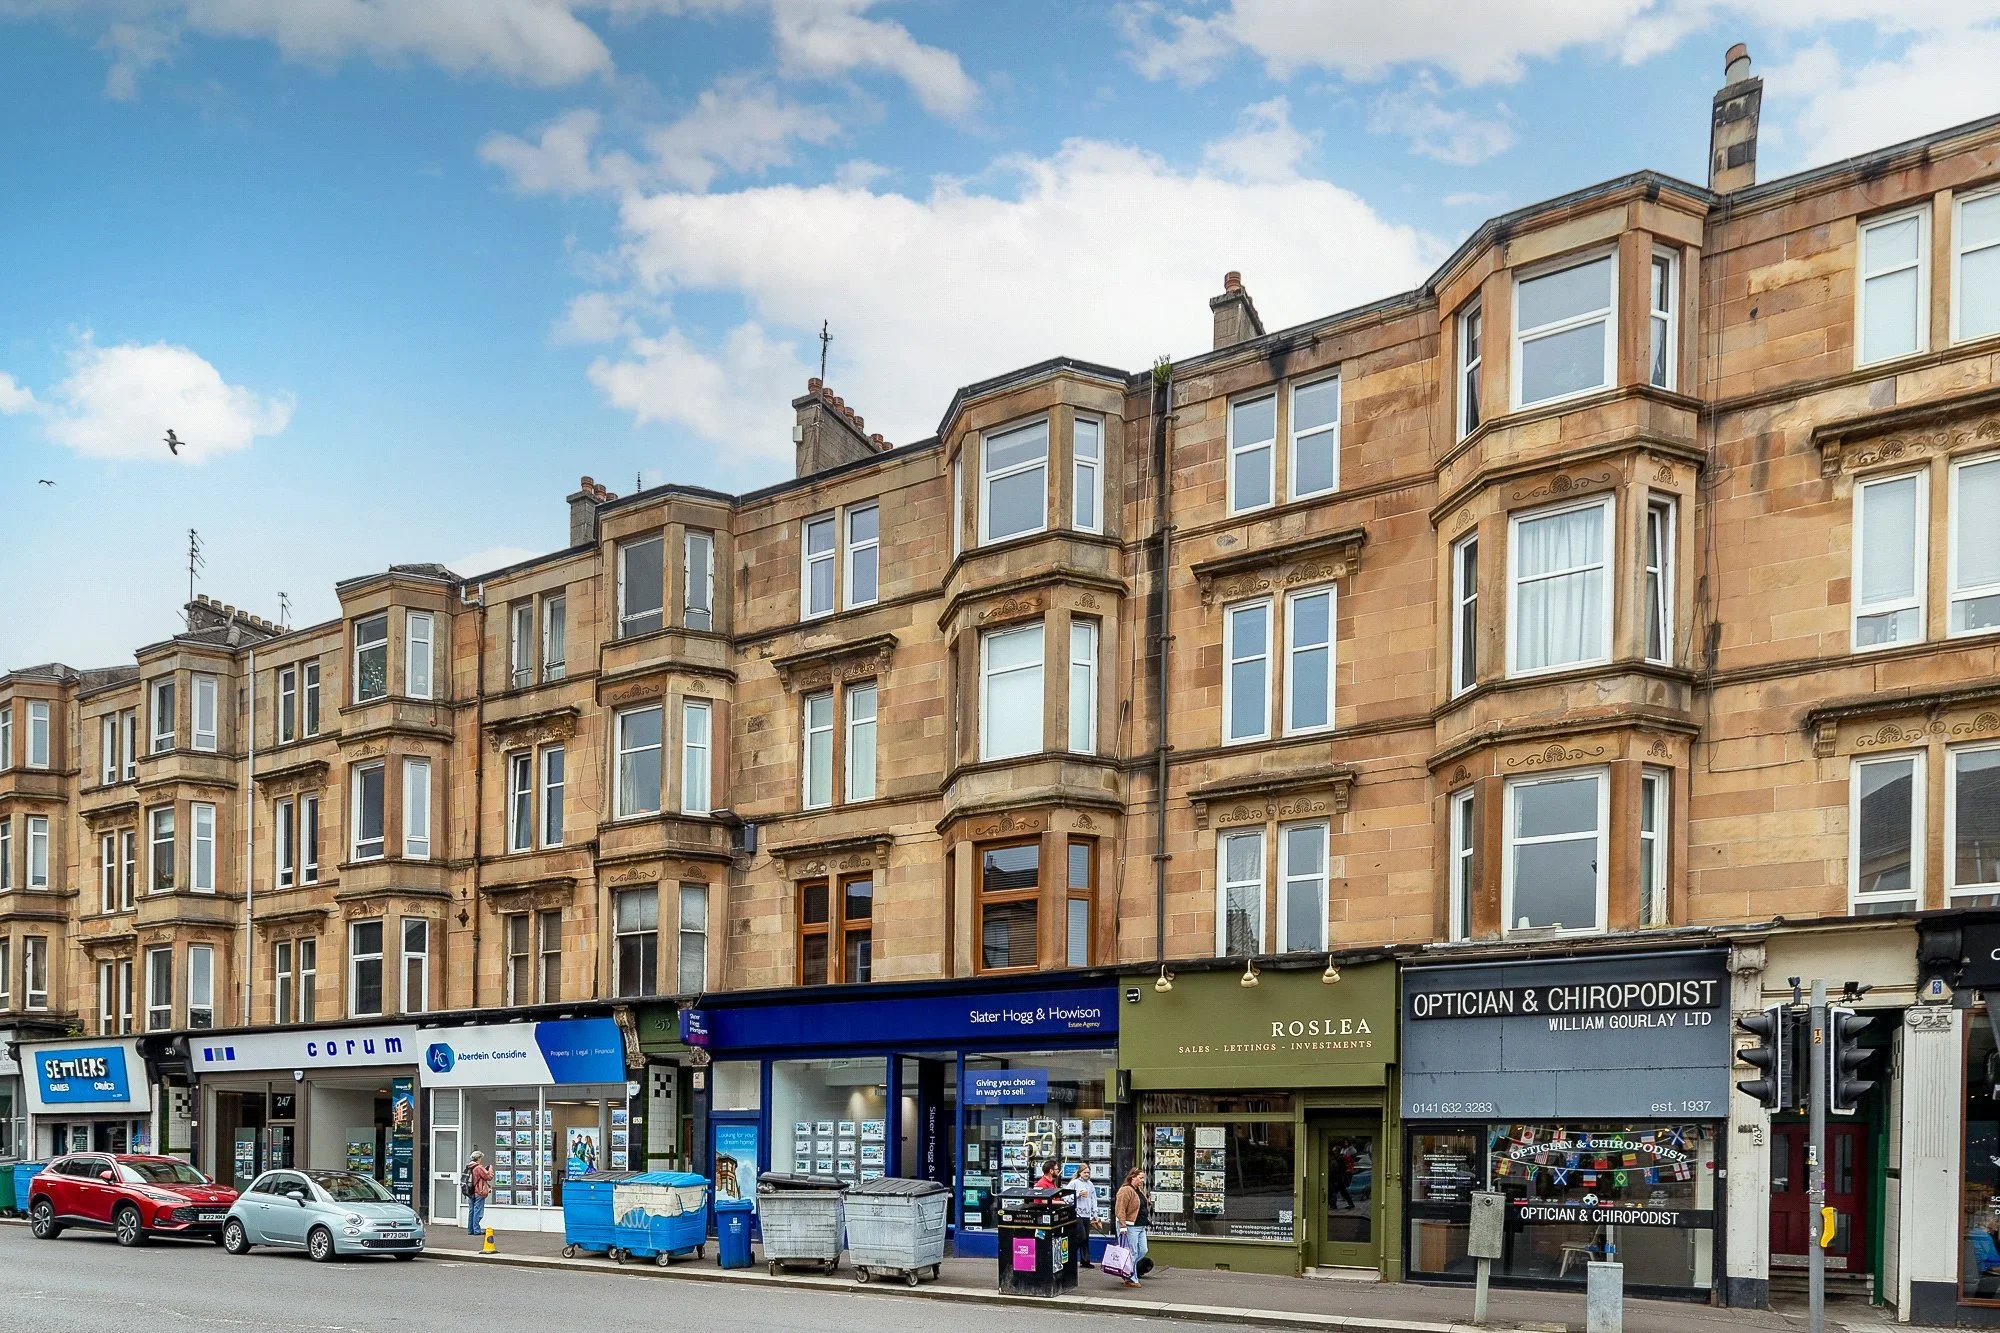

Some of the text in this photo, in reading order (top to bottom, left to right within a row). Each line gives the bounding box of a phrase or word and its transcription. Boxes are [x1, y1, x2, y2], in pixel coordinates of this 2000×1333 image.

[1413, 980, 1717, 1017] OPTICIAN & CHIROPODIST
[969, 1006, 1101, 1024] Slater Hogg & Howison
[1548, 1012, 1712, 1031] WILLIAM GOURLAY LTD
[1082, 1021, 1101, 1029] Agency
[1271, 1018, 1372, 1037] ROSLEA
[306, 1037, 403, 1057] corum
[457, 1049, 527, 1061] Aberdein Considine
[1178, 1045, 1210, 1054] SALES
[1223, 1043, 1277, 1052] LETTINGS
[1291, 1041, 1373, 1051] INVESTMENTS
[45, 1057, 106, 1079] SETTLERS
[49, 1083, 70, 1092] GAMES
[975, 1088, 983, 1096] in
[984, 1089, 1001, 1098] ways
[1011, 1087, 1026, 1097] sell.
[976, 1079, 1036, 1089] Giving you choice
[276, 1096, 291, 1107] 247
[1412, 1102, 1493, 1114] 0141 632 3283
[1650, 1100, 1712, 1112] est. 1937
[927, 1136, 936, 1163] Hogg
[1022, 1131, 1057, 1158] 50
[1510, 1139, 1688, 1162] OPTICIAN & CHIROPODIST
[1520, 1206, 1680, 1225] OPTICIAN & CHIROPODIST
